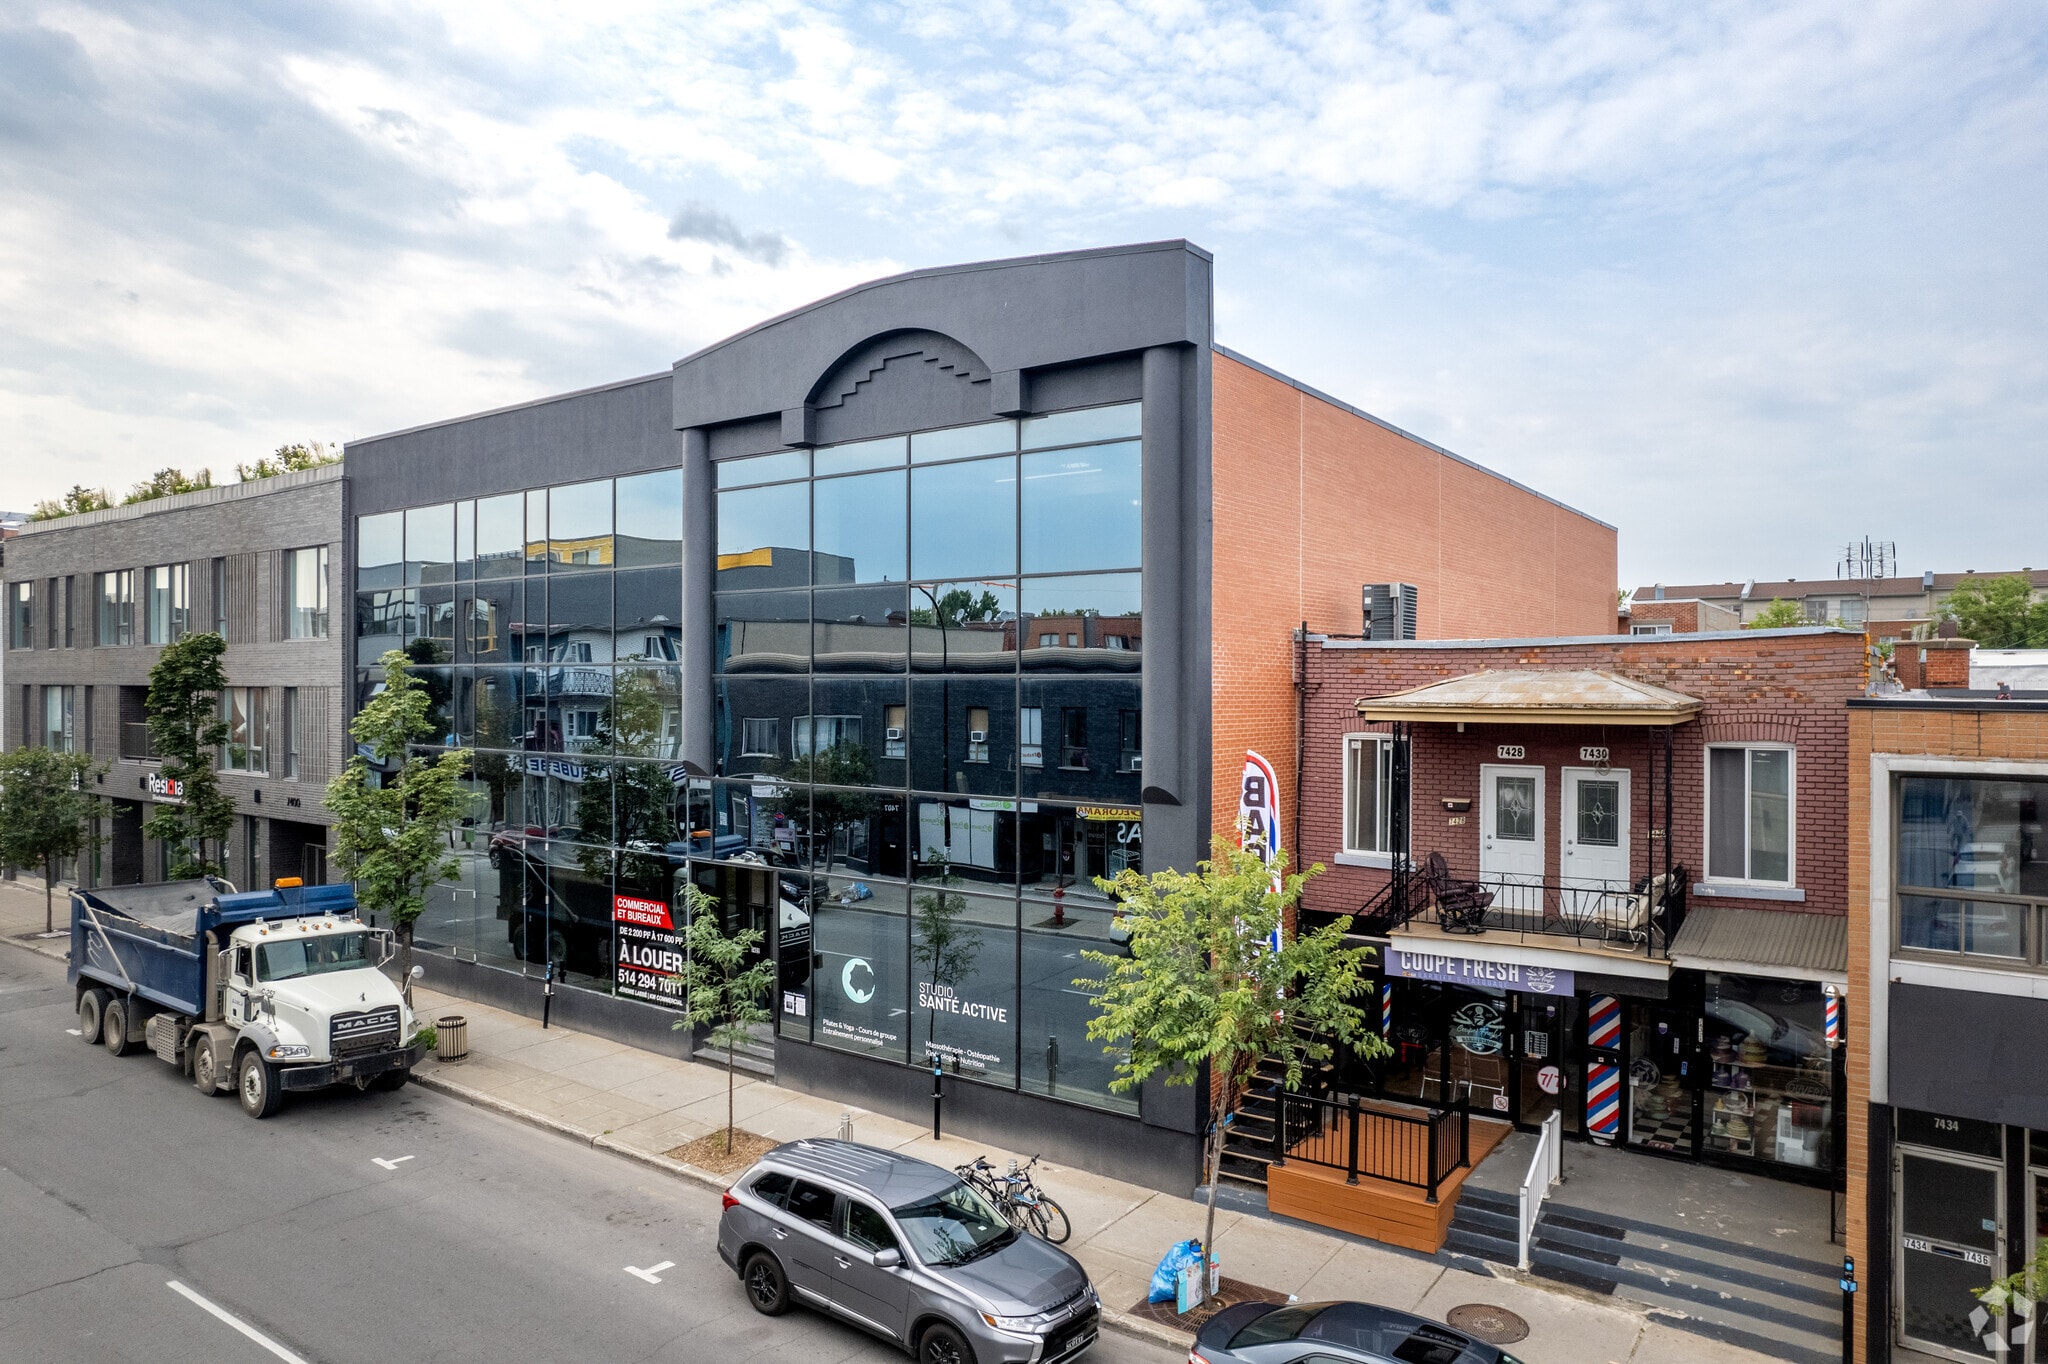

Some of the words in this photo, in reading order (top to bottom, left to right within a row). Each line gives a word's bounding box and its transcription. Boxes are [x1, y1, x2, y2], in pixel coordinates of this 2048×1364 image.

[1499, 746, 1523, 757] 7428
[1582, 748, 1608, 760] 7430
[617, 898, 665, 915] COMMERCIAL
[617, 909, 626, 919] ET
[627, 912, 662, 925] BUREAUX
[620, 926, 628, 935] DE
[643, 930, 651, 939] PF
[651, 930, 656, 941] À
[657, 933, 663, 942] 17
[675, 936, 684, 945] PF
[619, 938, 630, 963] À
[633, 945, 683, 974] LOUER
[1401, 952, 1456, 975] COUPE
[1463, 958, 1520, 983] FRESH
[618, 968, 636, 986] 514
[637, 972, 657, 990] 294
[658, 977, 683, 996] 7011
[919, 982, 954, 998] STUDIO
[919, 994, 960, 1014] SANTÉ
[961, 1001, 1007, 1023] ACTIVE
[337, 1014, 395, 1030] MACK
[843, 1022, 855, 1032] Yoga
[858, 1026, 873, 1036] Cours
[872, 1029, 880, 1037] de
[879, 1032, 897, 1041] groupe
[925, 1040, 964, 1055] Massothérapie
[966, 1049, 1001, 1063] Ostéopathie
[960, 1056, 985, 1069] Nutrition
[1933, 1117, 1960, 1132] 7434
[1904, 1238, 1927, 1251] 7434
[1965, 1251, 1989, 1265] 7436
